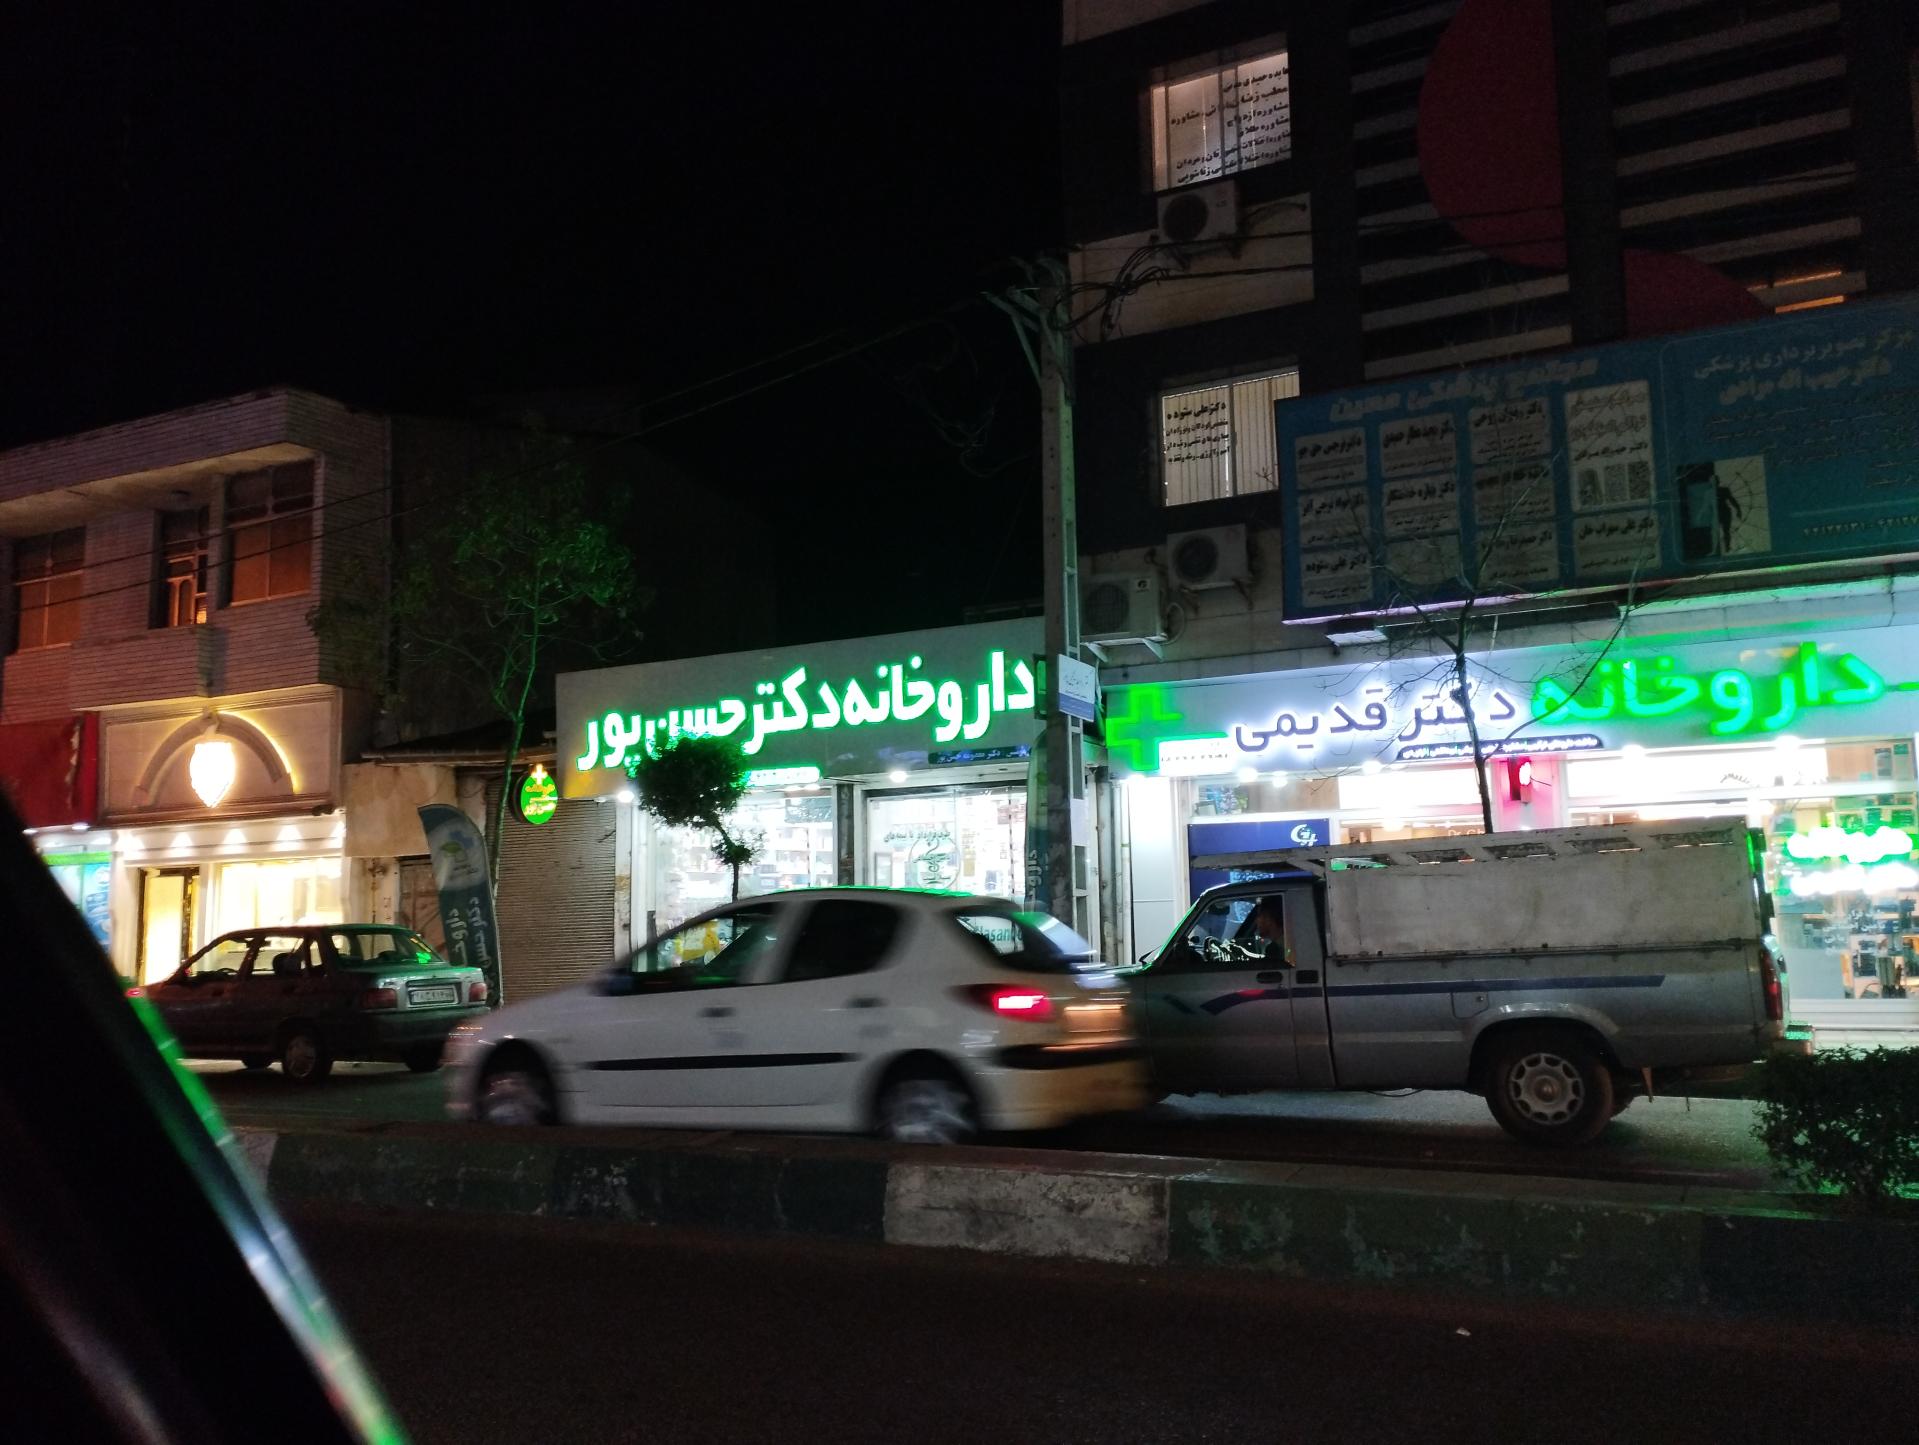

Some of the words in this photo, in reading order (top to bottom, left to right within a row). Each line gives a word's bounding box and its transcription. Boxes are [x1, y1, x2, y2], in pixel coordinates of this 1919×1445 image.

[1208, 402, 1227, 416] دکتر
[740, 666, 842, 756] دکتر
[842, 649, 1036, 743] داروخانه
[1235, 687, 1388, 753] قدیمی
[1398, 682, 1516, 743] دکتر
[1531, 641, 1885, 735] داروخانه
[575, 712, 642, 780] پور
